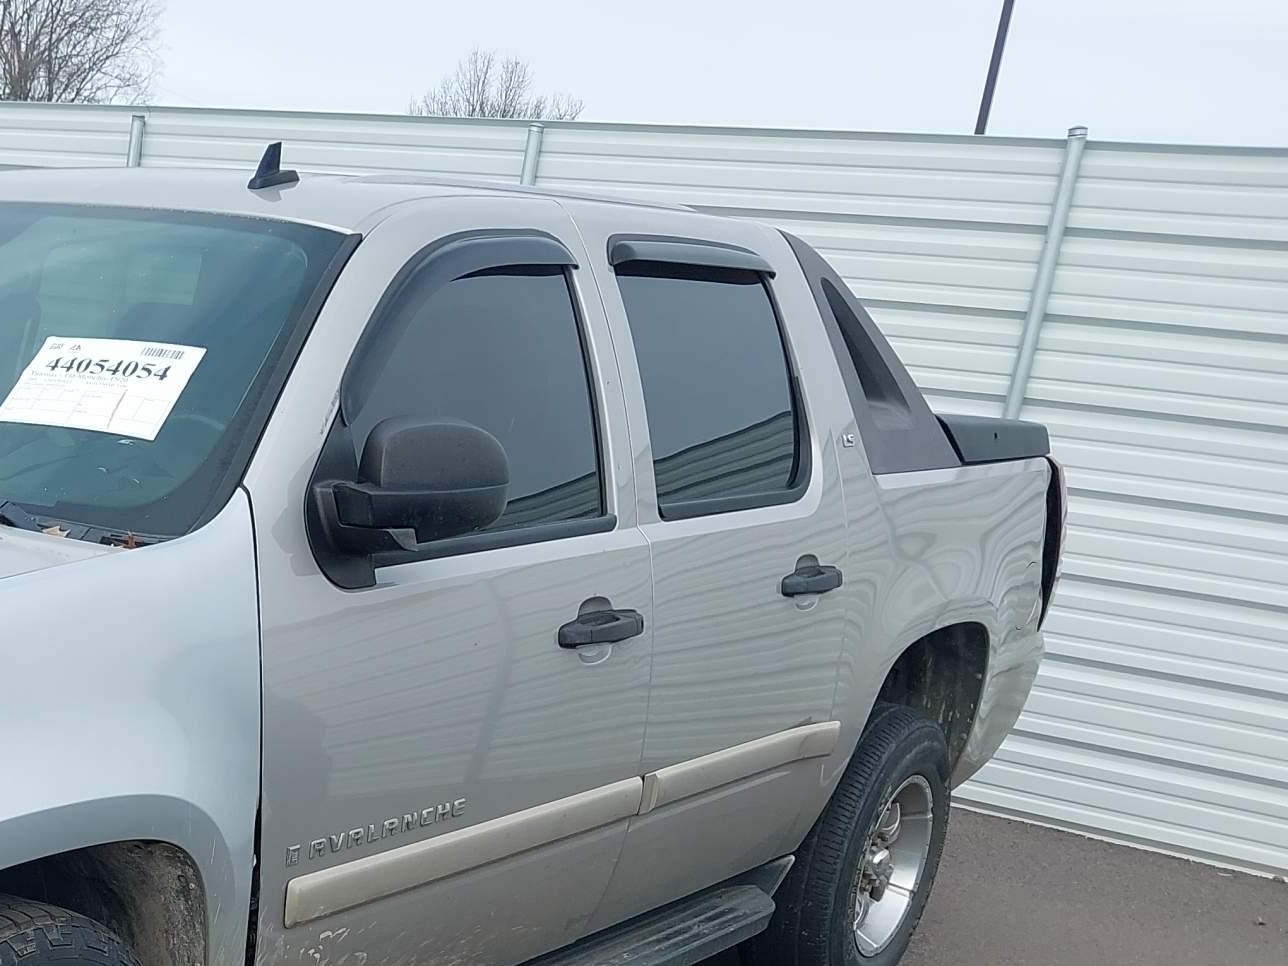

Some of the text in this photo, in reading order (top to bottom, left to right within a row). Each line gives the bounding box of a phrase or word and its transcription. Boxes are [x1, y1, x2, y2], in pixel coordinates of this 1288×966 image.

[45, 356, 171, 381] 44054054
[841, 433, 855, 448] LS
[309, 798, 467, 860] AVALANCHE
